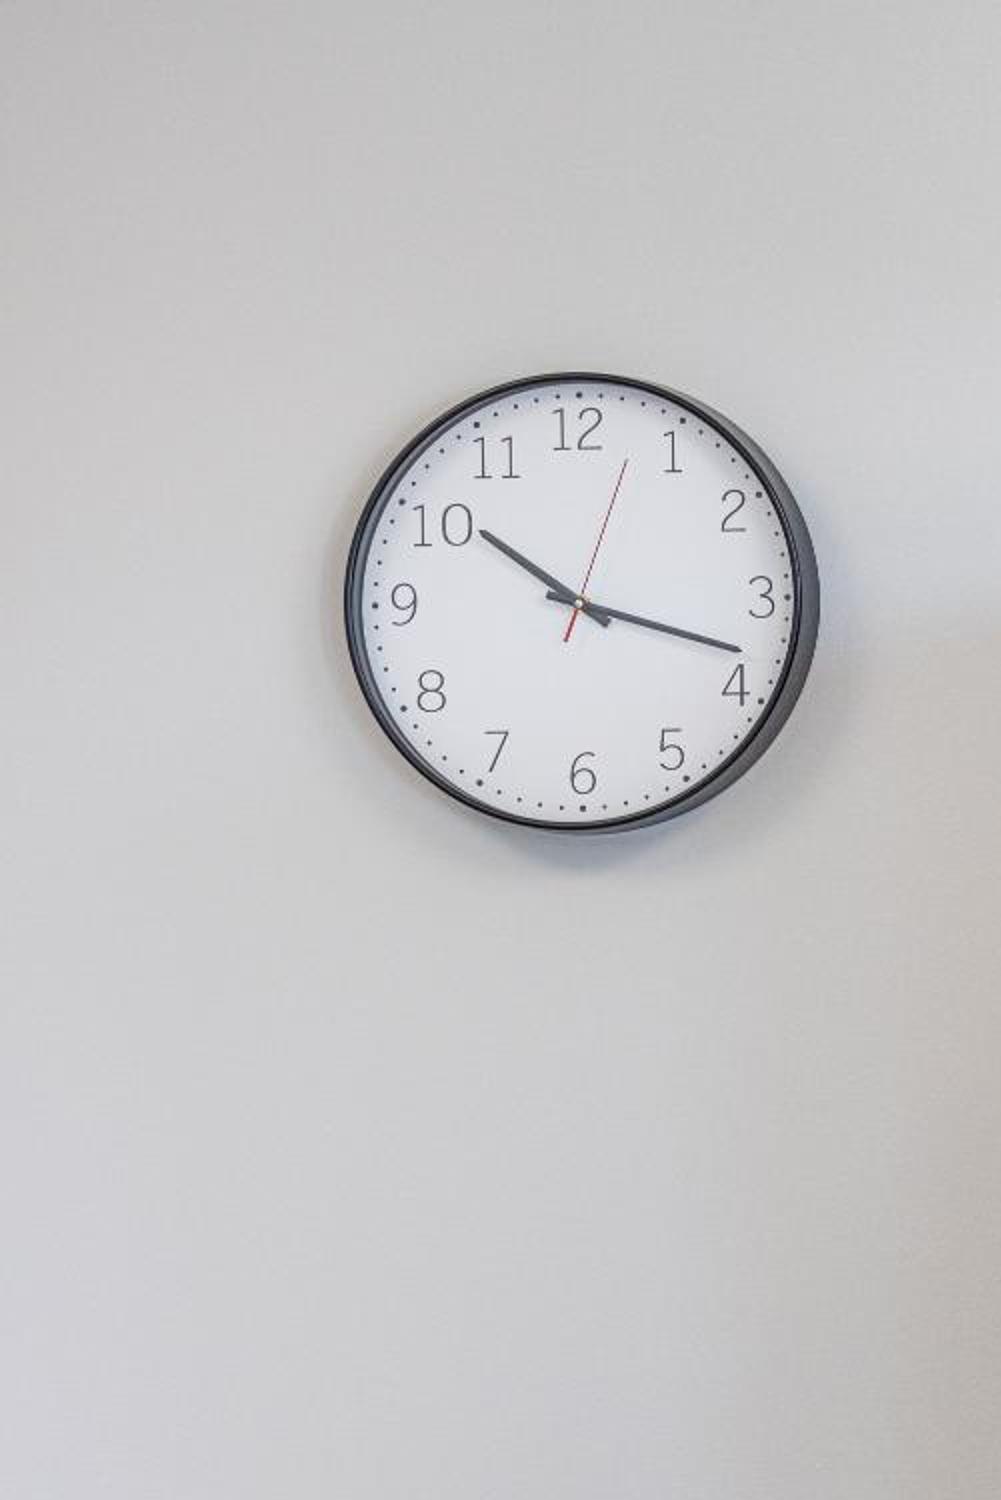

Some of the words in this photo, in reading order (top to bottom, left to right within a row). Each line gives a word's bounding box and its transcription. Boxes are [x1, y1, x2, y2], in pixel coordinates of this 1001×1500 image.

[551, 407, 603, 451] 12
[473, 436, 521, 480] 11
[663, 431, 683, 473] 1
[412, 503, 473, 548] 10
[720, 489, 747, 532] 2
[391, 583, 418, 626] 9
[748, 575, 775, 619] 3
[416, 670, 447, 713] 8
[721, 663, 751, 707] 4
[484, 730, 509, 773] 7
[659, 728, 685, 771] 5
[569, 752, 597, 795] 6
